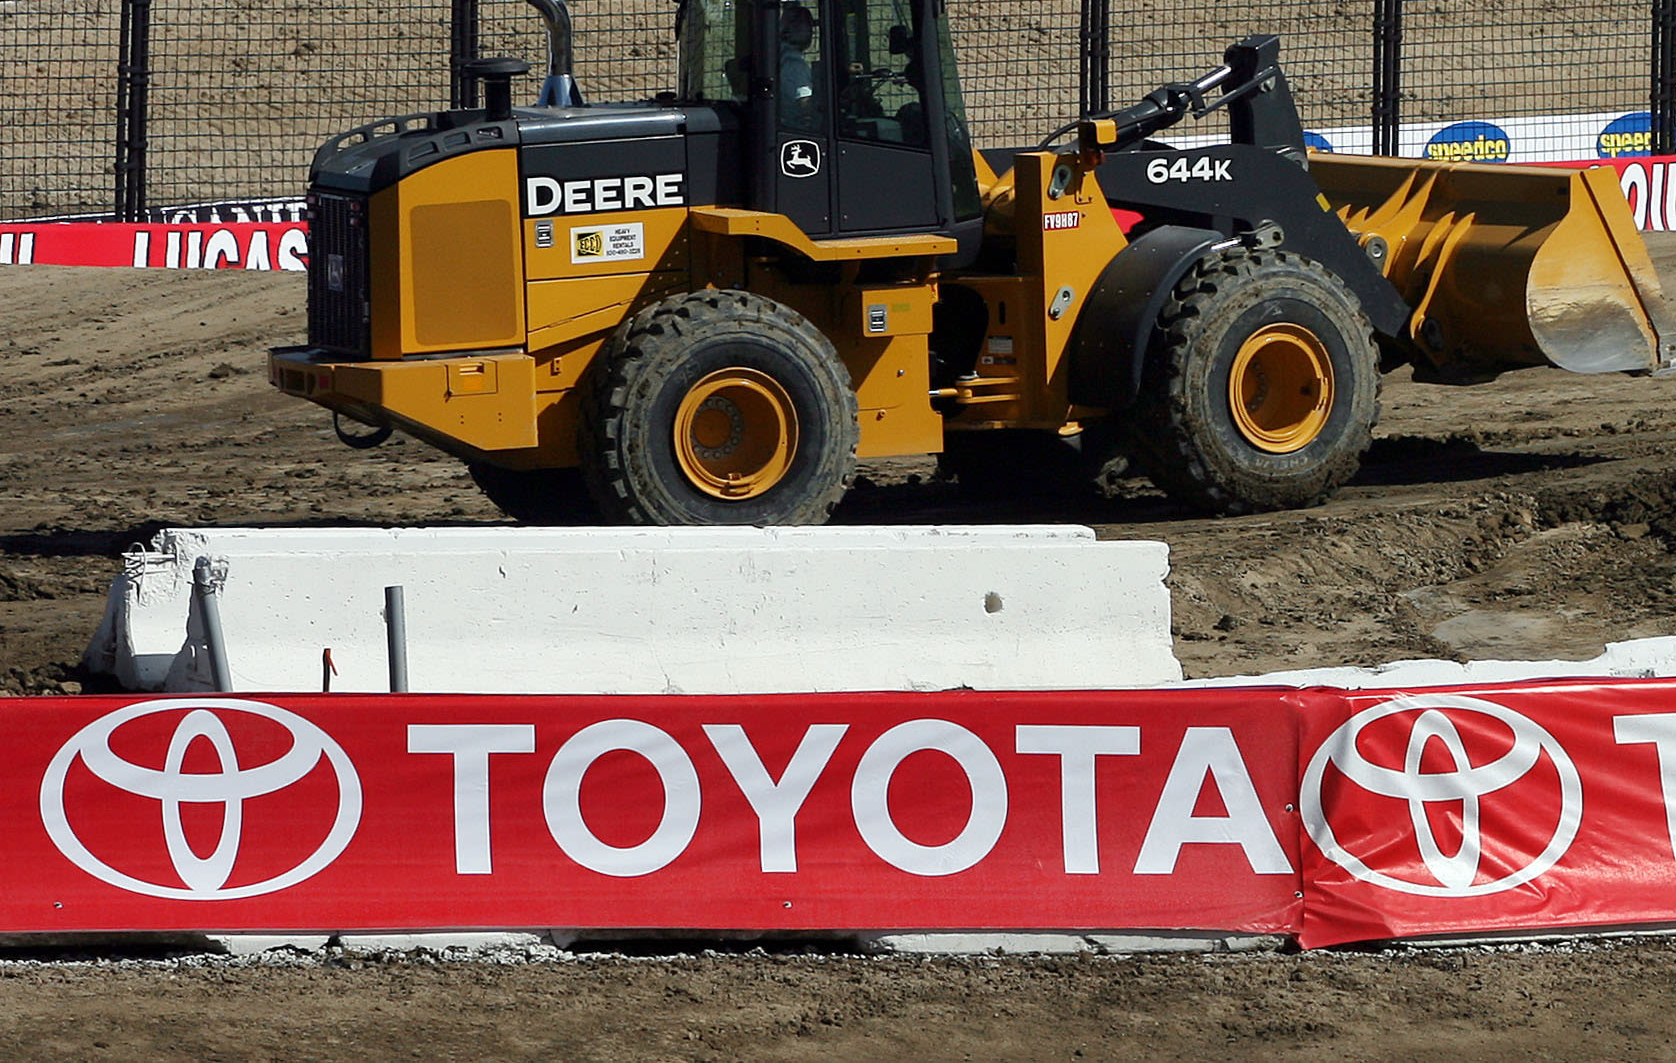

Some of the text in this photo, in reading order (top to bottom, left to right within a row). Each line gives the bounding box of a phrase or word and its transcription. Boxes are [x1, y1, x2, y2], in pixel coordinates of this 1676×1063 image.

[1146, 155, 1233, 184] 644K
[526, 173, 684, 216] DEERE
[1043, 211, 1079, 230] FV9H87
[406, 718, 1295, 878] TOYOTA
